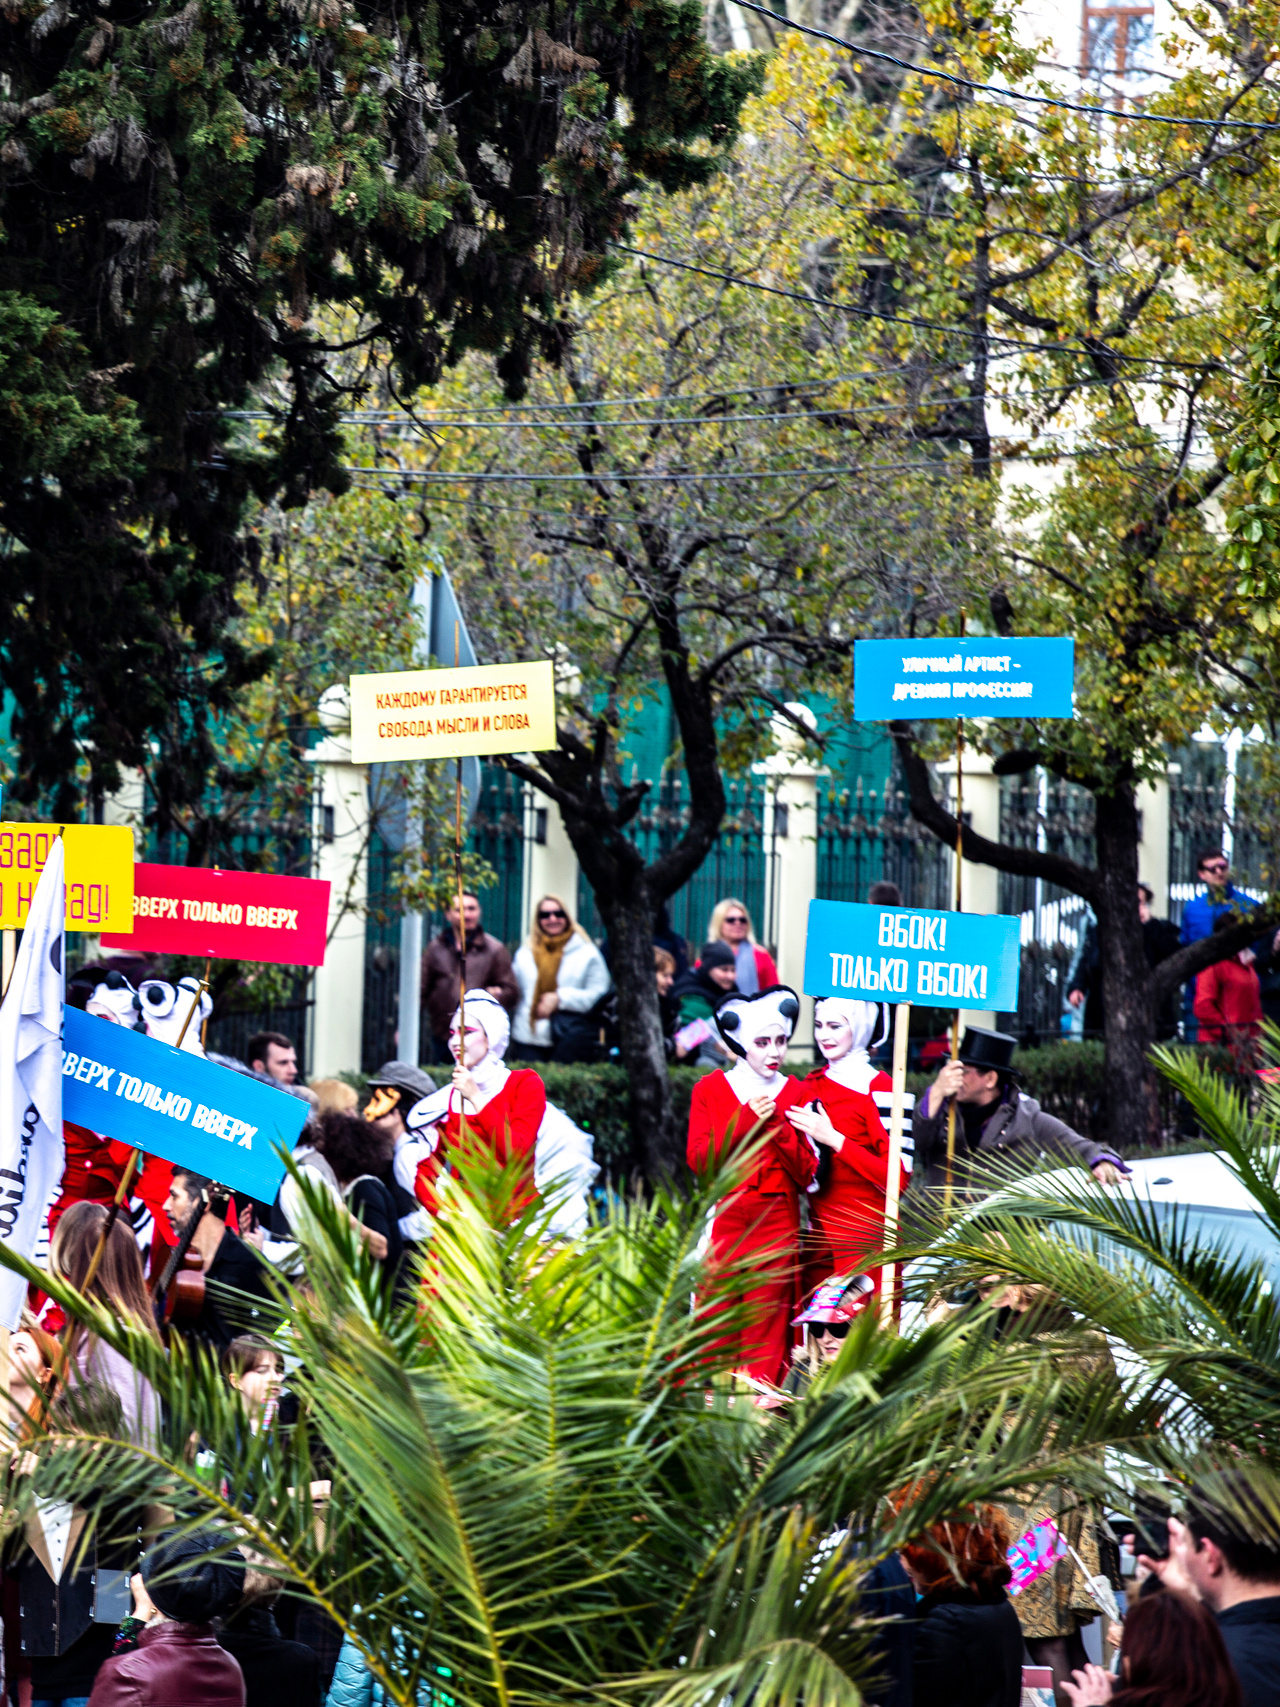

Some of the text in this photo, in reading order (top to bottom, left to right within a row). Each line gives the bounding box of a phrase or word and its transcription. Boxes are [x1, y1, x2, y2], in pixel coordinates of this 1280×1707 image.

[964, 656, 1012, 673] АРТИСТ
[376, 684, 527, 710] КАЖДОМУ ГАРАНТИРУЕТСЯ
[379, 713, 530, 738] СВОБОДА МЫСЛИ И СЛОВА
[182, 899, 242, 926] ТОЛЬКО
[245, 906, 298, 931] ВВЕРХ
[878, 912, 947, 951] ВБОК!
[829, 952, 988, 999] ТОЛЬКО ВБОК!
[62, 1050, 259, 1151] ВЕРХ ТОЛЬКО ВВЕРХ
